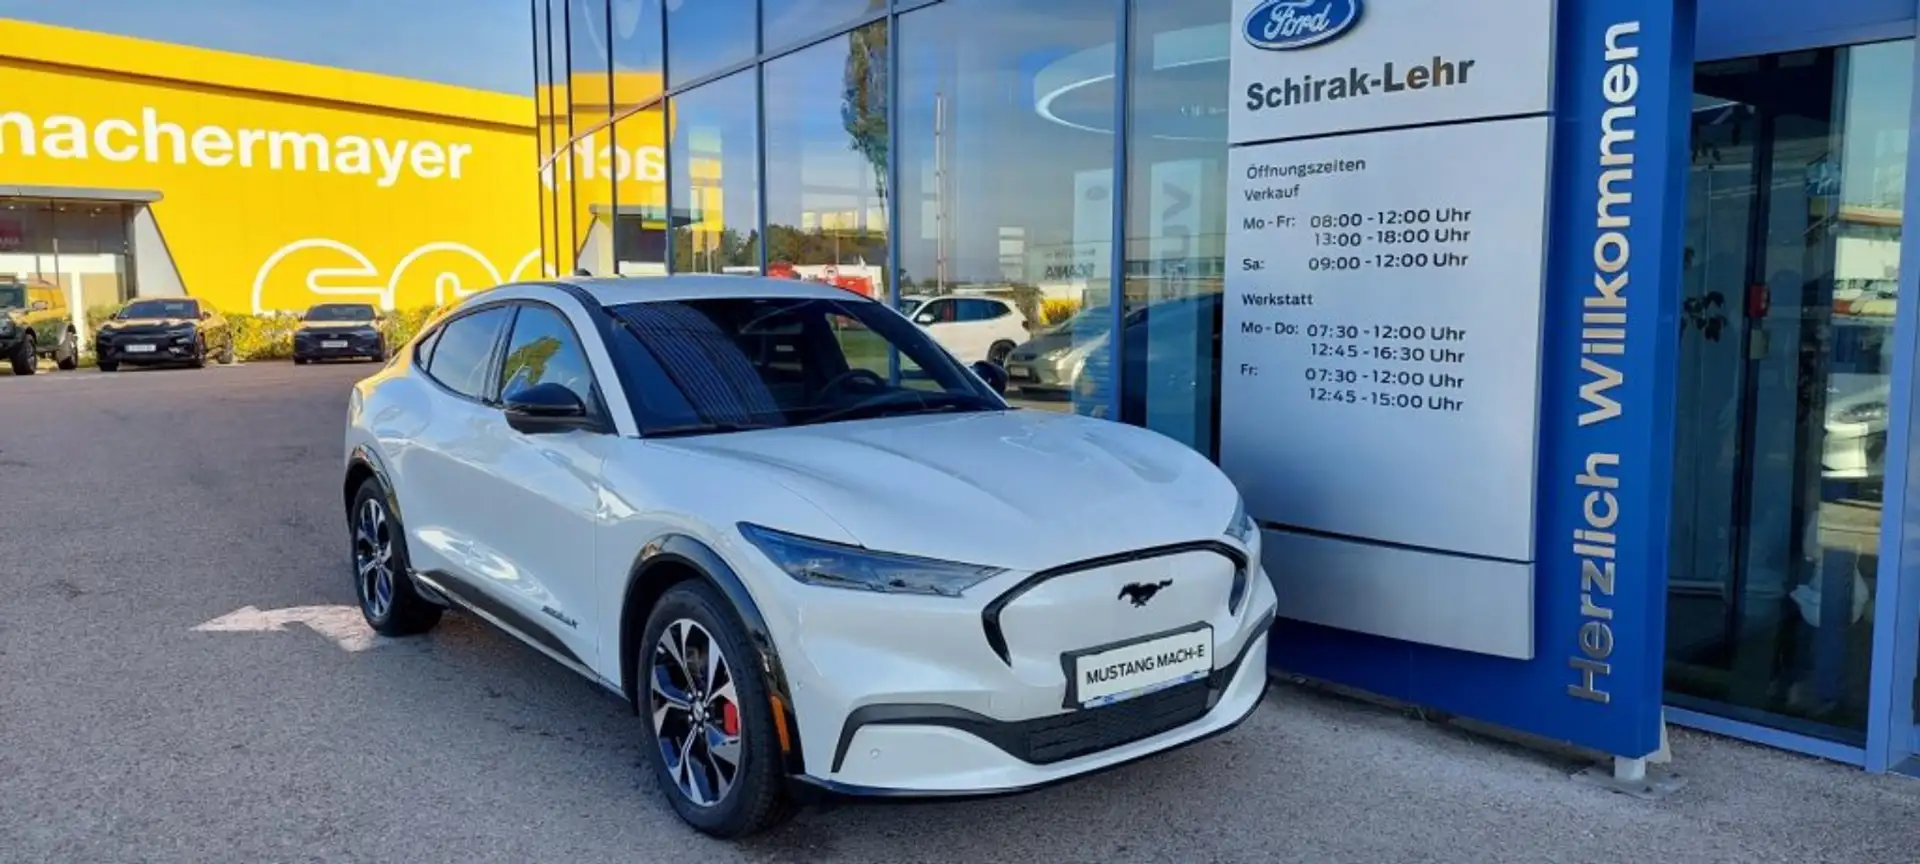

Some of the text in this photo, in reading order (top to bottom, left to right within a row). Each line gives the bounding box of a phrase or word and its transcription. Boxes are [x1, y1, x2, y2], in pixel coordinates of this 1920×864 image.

[1263, 0, 1332, 40] Ford
[1246, 56, 1475, 111] Schirak-Lehr
[1246, 158, 1366, 181] Öffnungszeiten
[1244, 184, 1301, 201] Verkauf
[1310, 213, 1363, 228] 08:00
[1436, 208, 1472, 223] Uhr
[1314, 232, 1362, 247] 13:00
[1435, 228, 1471, 243] Uhr
[1242, 258, 1265, 272] Sa:
[1308, 256, 1361, 271] 09:00
[1433, 252, 1469, 267] Uhr
[1241, 293, 1314, 306] Werkstatt
[1307, 324, 1359, 339] 07:30
[1431, 327, 1467, 341] Uhr
[1311, 343, 1358, 358] 12:45
[1430, 348, 1465, 363] Uhr
[1567, 21, 1640, 704] Herzlich Willkommen
[1240, 363, 1258, 376] Fr:
[1305, 368, 1357, 384] 07:30
[1429, 373, 1464, 389] Uhr
[1310, 387, 1356, 404] 12:45
[1428, 395, 1464, 411] Uhr
[1086, 644, 1205, 685] MUSTANG MACH-E
